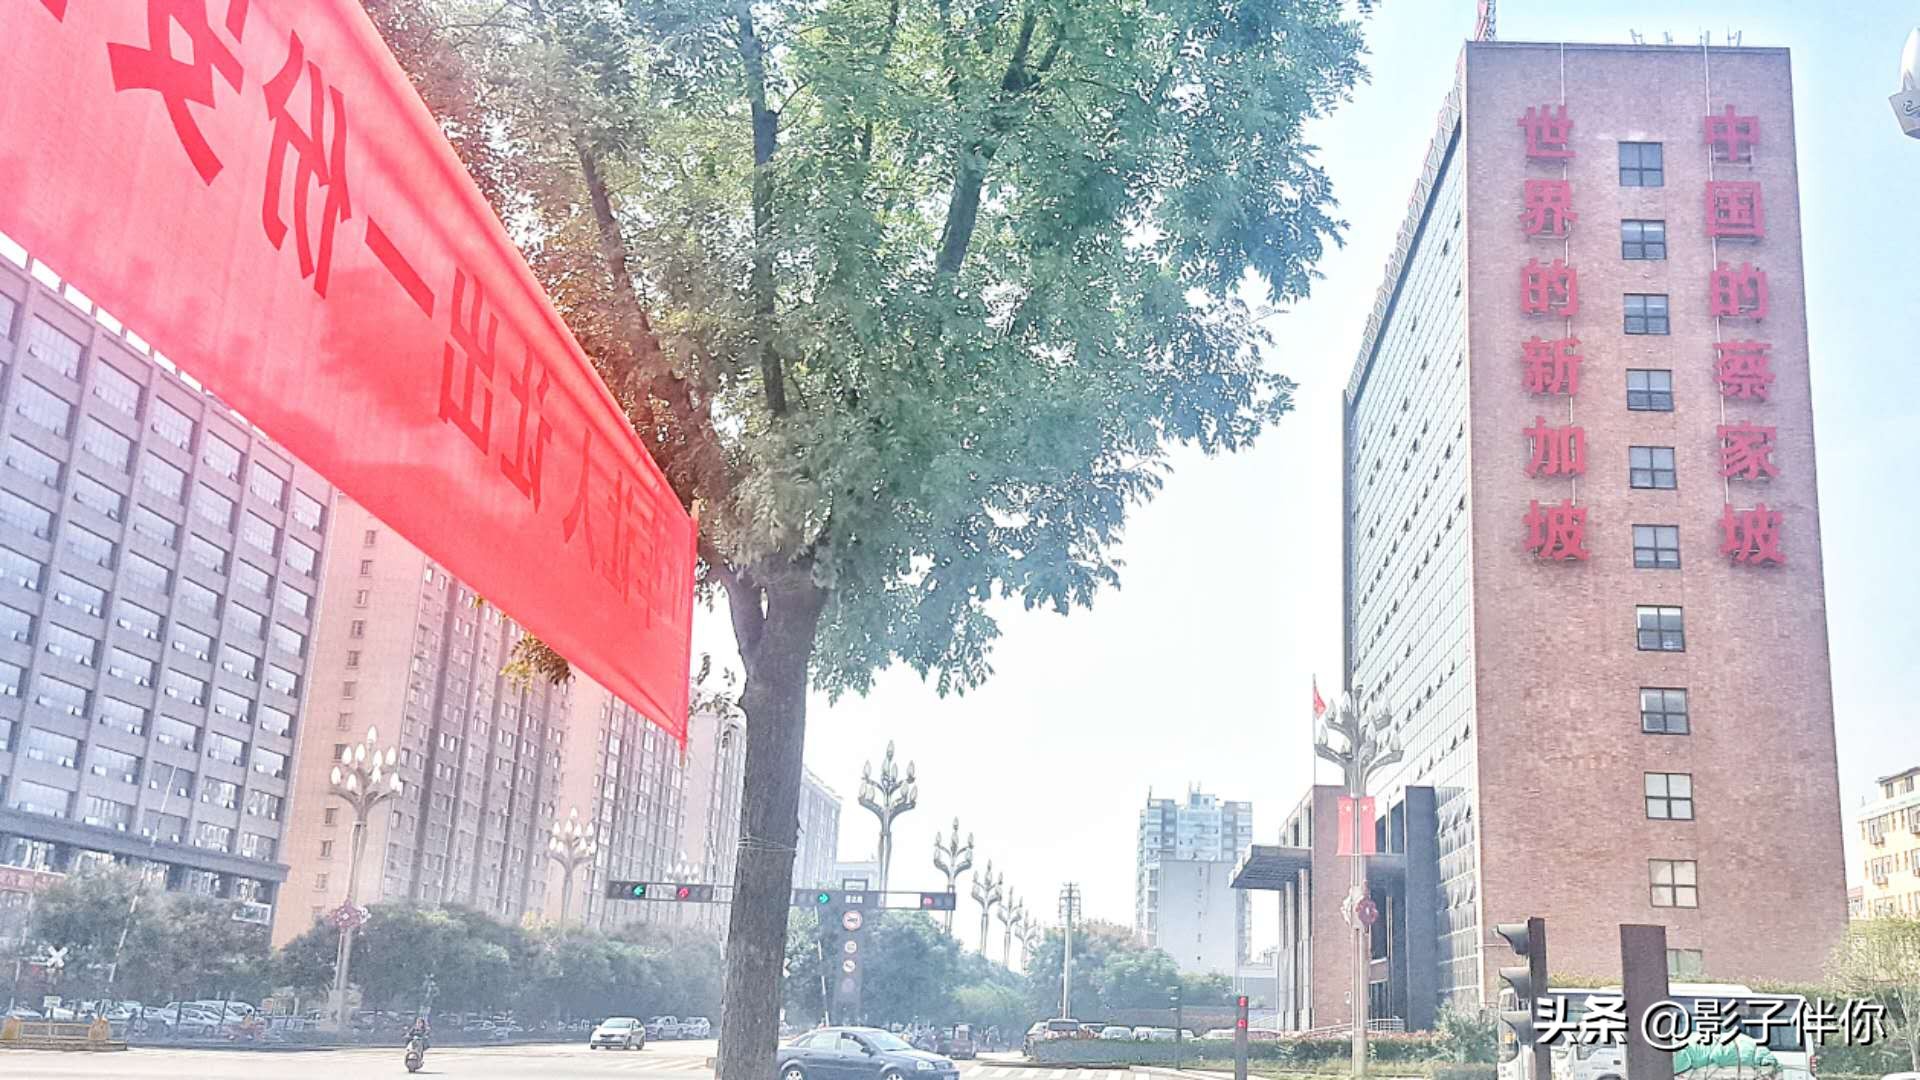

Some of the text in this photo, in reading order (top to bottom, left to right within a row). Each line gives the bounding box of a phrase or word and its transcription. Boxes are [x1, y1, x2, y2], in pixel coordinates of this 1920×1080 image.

[1517, 104, 1590, 562] 世界的新加坡
[1704, 104, 1787, 566] 中国的蔡家坡
